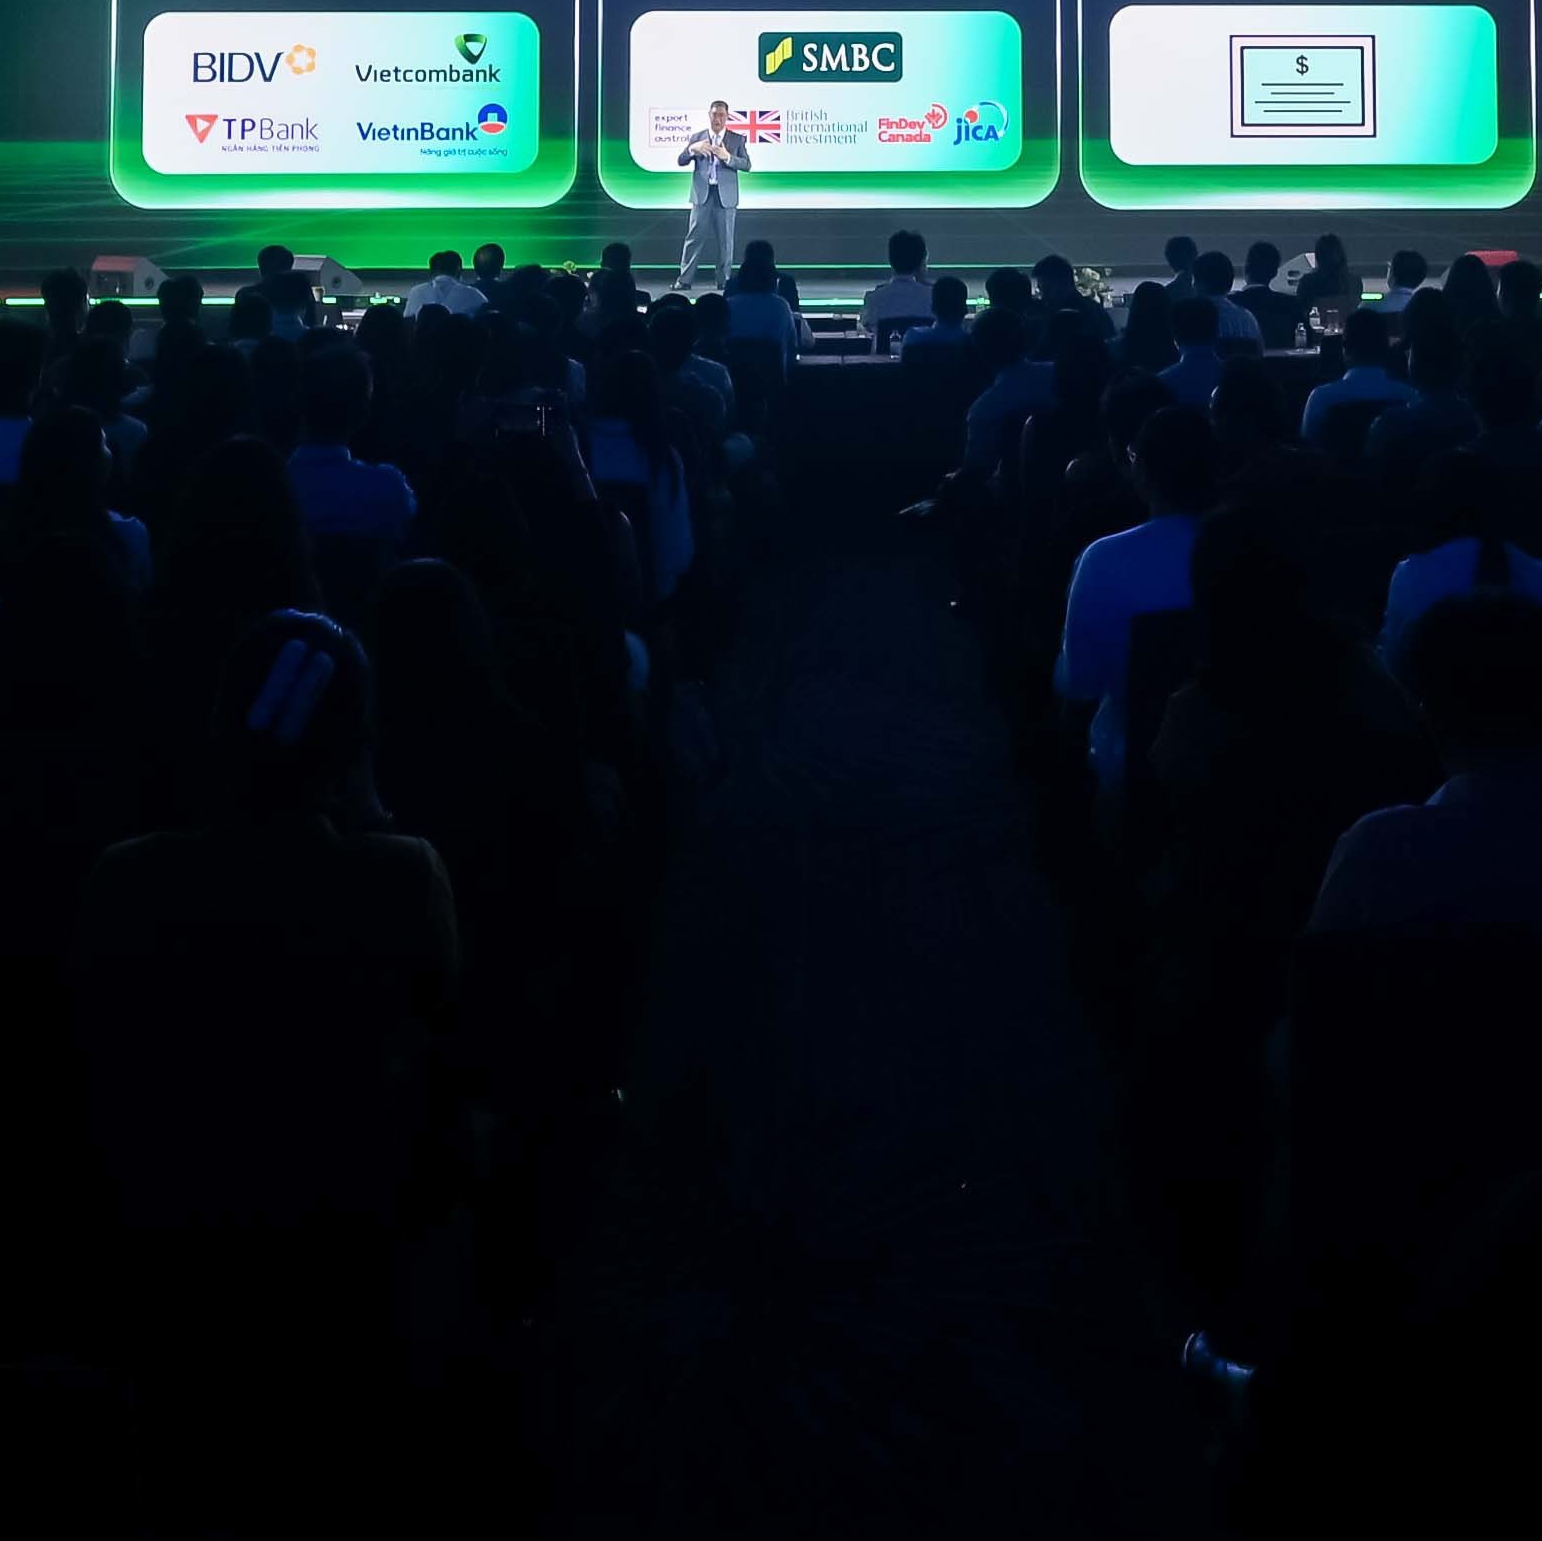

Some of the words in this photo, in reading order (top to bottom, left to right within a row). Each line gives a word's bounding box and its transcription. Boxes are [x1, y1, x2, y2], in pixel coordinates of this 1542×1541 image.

[803, 43, 895, 72] SMBC
[193, 52, 284, 82] BIDV
[355, 64, 501, 83] Vietcombank
[787, 109, 828, 121] British
[223, 117, 318, 140] TPBank
[357, 122, 478, 141] VietinBank
[787, 121, 867, 132] International
[879, 118, 926, 130] FinDev
[787, 132, 856, 144] Investment
[878, 131, 931, 142] Canada
